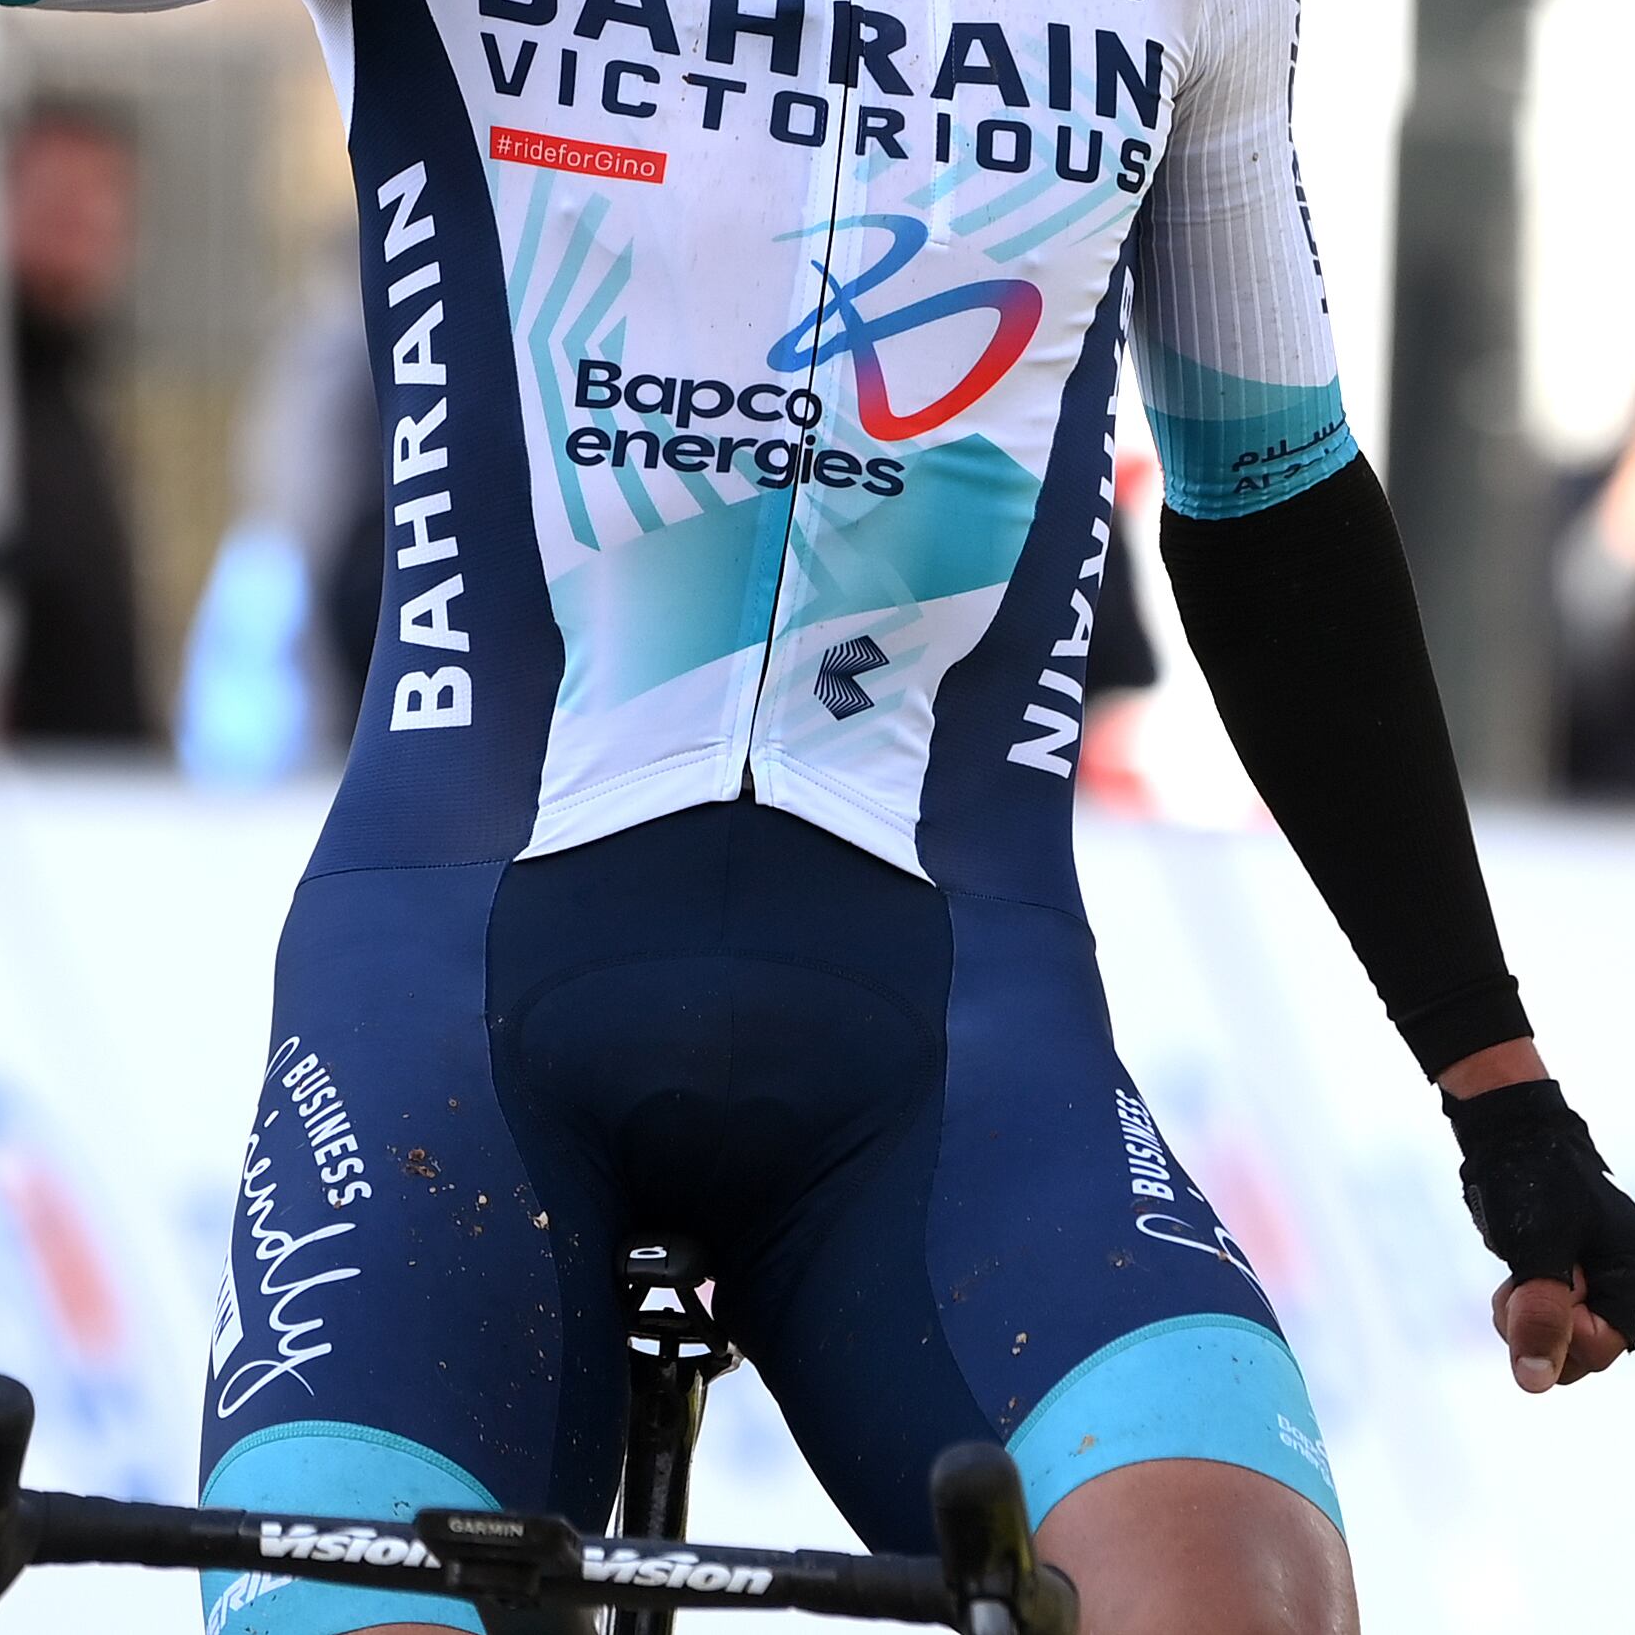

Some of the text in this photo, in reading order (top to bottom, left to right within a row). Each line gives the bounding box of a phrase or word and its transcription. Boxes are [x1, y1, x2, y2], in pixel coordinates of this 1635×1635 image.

[478, 31, 1148, 195] VICTORIOUS
[496, 132, 658, 179] #rideforGino
[574, 358, 823, 430] Bapco
[377, 160, 473, 733] BAHRAIN
[565, 426, 906, 497] energies
[282, 1053, 373, 1208] BUSINESS
[1115, 1088, 1175, 1202] BUSINESS
[259, 1520, 442, 1569] Vision
[448, 1517, 524, 1539] GARMIN
[581, 1546, 774, 1596] Vision
